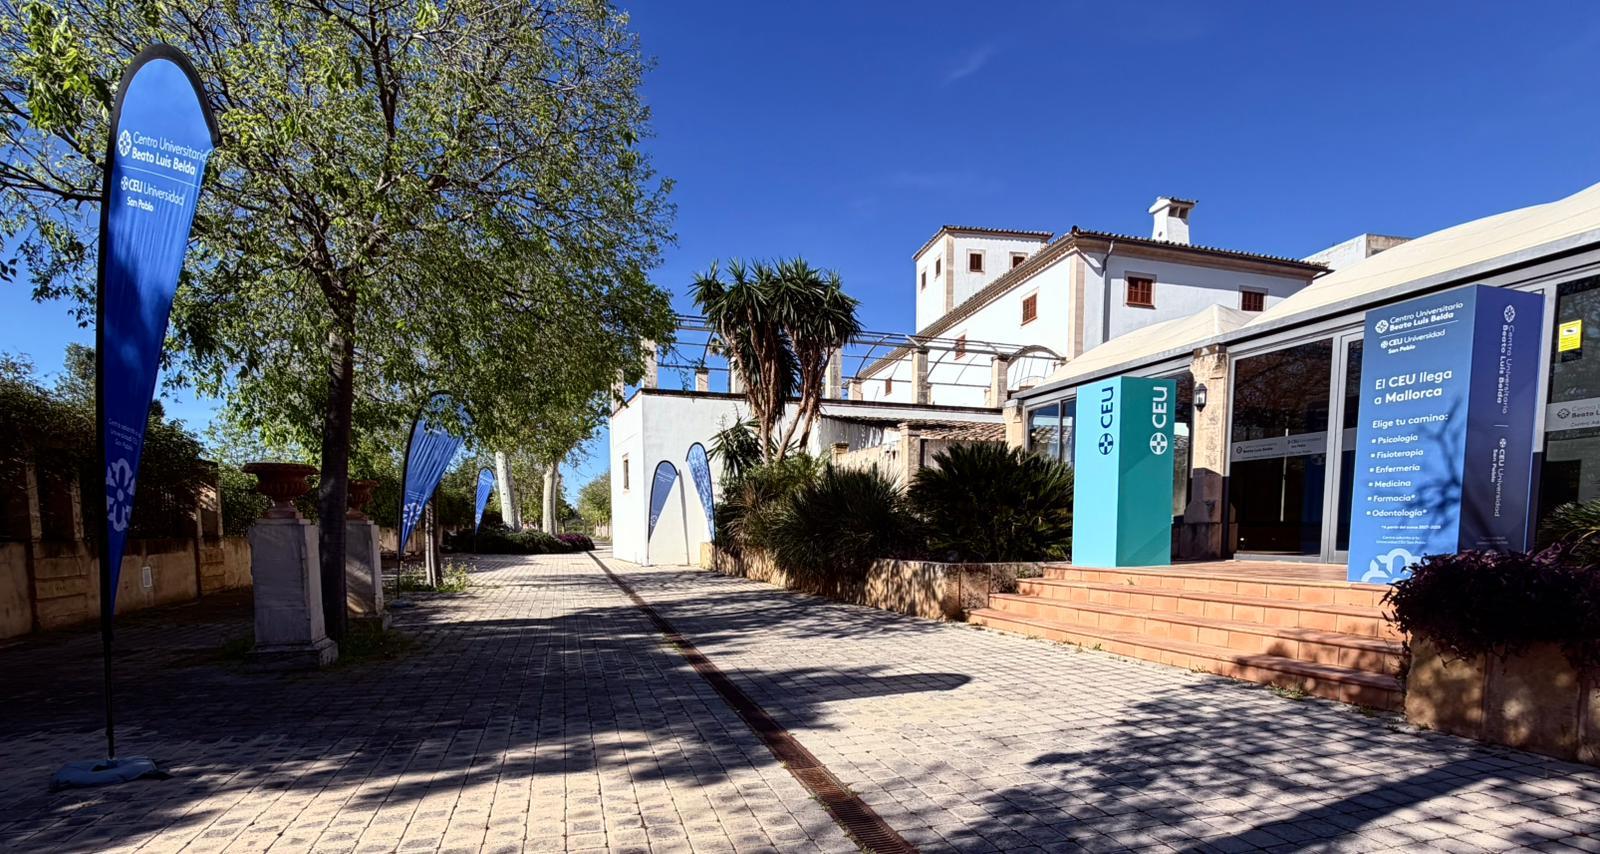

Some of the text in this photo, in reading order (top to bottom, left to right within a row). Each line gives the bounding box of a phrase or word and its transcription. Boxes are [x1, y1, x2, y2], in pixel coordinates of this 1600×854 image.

[133, 131, 158, 148] Centro
[131, 147, 196, 176] Beato Luis Belda
[128, 178, 185, 205] CEU Universidad
[126, 196, 154, 212] San Pablo
[1389, 302, 1464, 324] Centro Universitario
[1389, 312, 1454, 332] Beato Luis Belda
[1388, 328, 1446, 347] CEU Universidad
[1496, 324, 1509, 404] Beato Luis Belda
[1502, 324, 1515, 414] Centro Universitario
[1375, 370, 1453, 390] El CEU llega
[1374, 387, 1443, 405] a Mallorca
[1100, 386, 1114, 429] CEU
[1152, 386, 1168, 429] CEU
[1372, 413, 1449, 430] Elige tu camino:
[1377, 433, 1419, 445] Psicología
[1376, 448, 1424, 459] Fisioterapia
[1375, 464, 1421, 474] Enfermería
[1374, 480, 1412, 488] Medicina
[1494, 468, 1504, 517] Universidad
